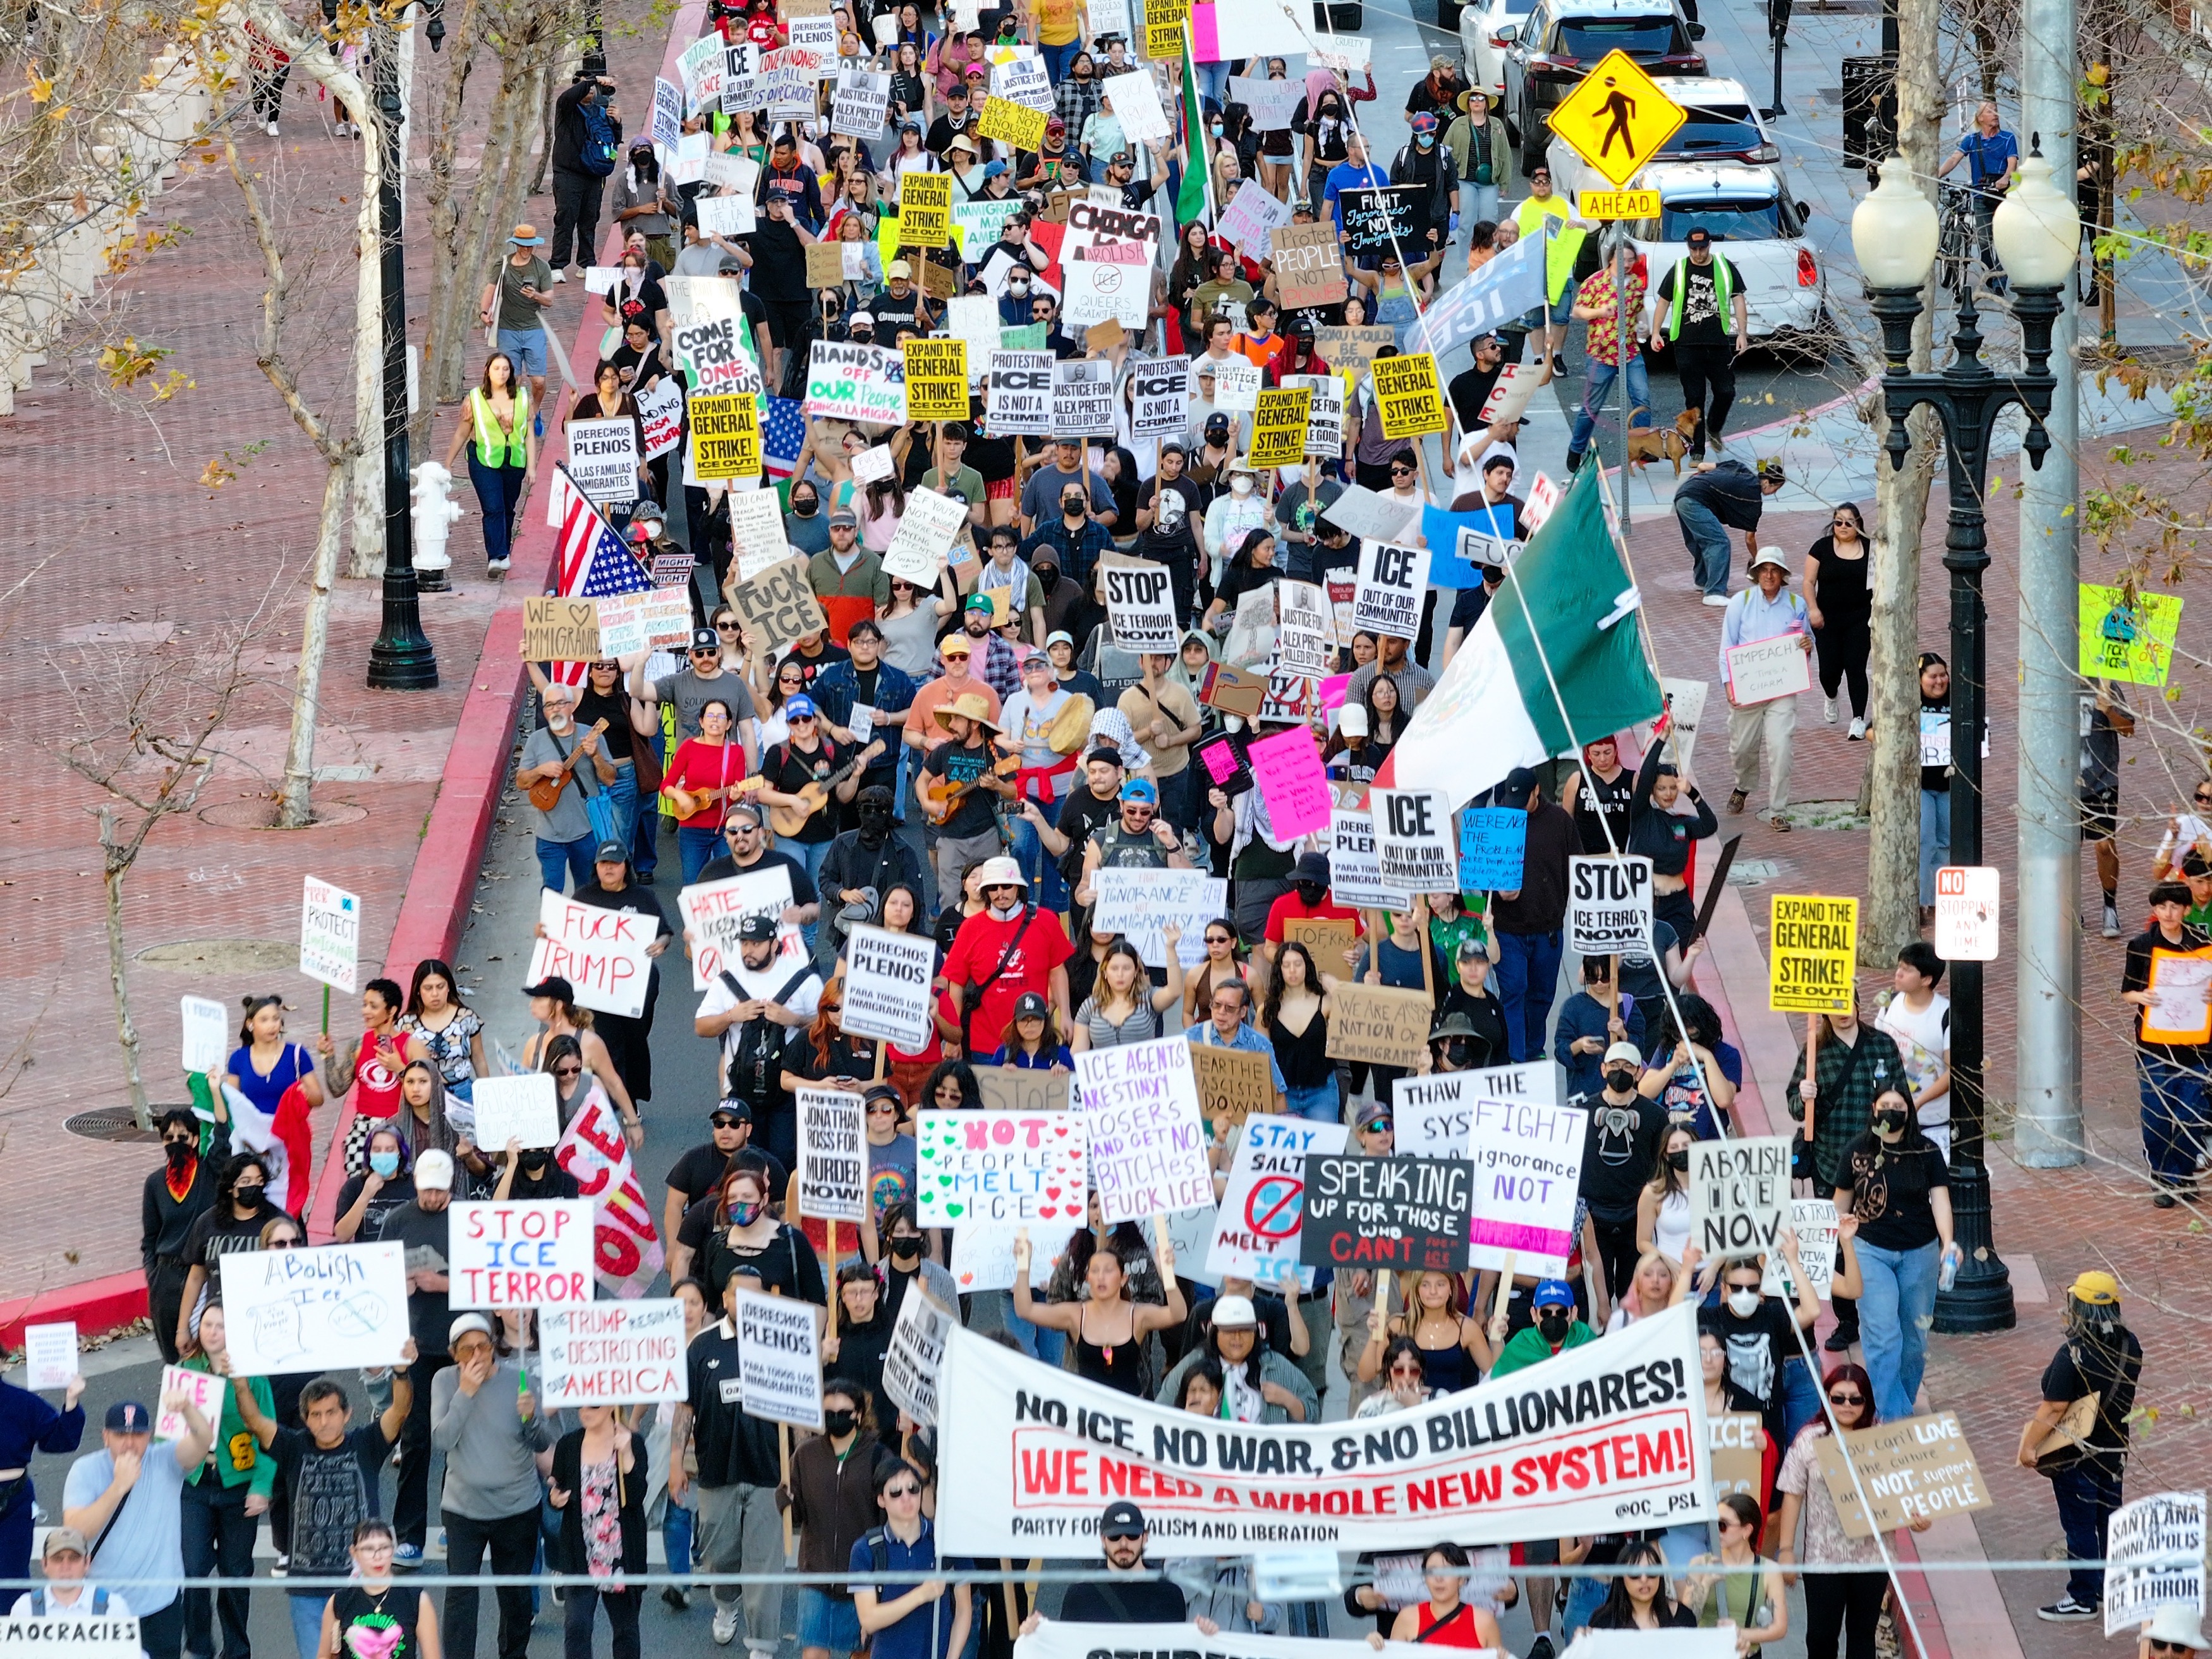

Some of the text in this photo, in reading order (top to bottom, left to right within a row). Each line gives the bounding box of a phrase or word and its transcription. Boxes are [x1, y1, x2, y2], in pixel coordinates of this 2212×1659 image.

[793, 23, 832, 32] ¡DERECHOS
[1093, 16, 1122, 30] RIGHT
[793, 32, 833, 44] PLENOS
[1335, 37, 1364, 47] CRUELTY
[728, 47, 749, 76] ICE
[838, 88, 885, 105] JUSTICE FOR
[836, 104, 882, 121] ALEX PRETTI
[989, 96, 1048, 122] TOO MUCH
[836, 115, 880, 130] KILLED BY CBP
[986, 118, 1033, 138] ENOUGH
[1017, 115, 1040, 130] NOT
[976, 124, 1039, 150] CARDBOARD
[904, 175, 949, 189] EXPAND THE
[902, 190, 947, 207] GENERAL
[1361, 193, 1401, 209] FIGHT
[1590, 195, 1650, 214] AHEAD
[904, 210, 944, 228] STRIKE!
[1069, 204, 1160, 243] CHINGA
[1281, 227, 1337, 248] Protect
[1087, 241, 1144, 262] ABOLISH
[1275, 243, 1341, 272] PEOPLE
[1097, 274, 1117, 285] ICE
[1295, 269, 1330, 287] NOT
[1080, 295, 1131, 309] QUEERS
[1284, 283, 1346, 307] POWER
[1073, 308, 1109, 319] AGAINST
[678, 319, 733, 350] COME
[1315, 327, 1392, 341] GOKU WOULD
[695, 341, 733, 369] FOR
[813, 344, 883, 371] HANDS
[992, 354, 1052, 368] PROTESTING
[1340, 343, 1358, 356] BE
[700, 360, 749, 385] ONE,
[842, 367, 872, 381] OFF
[992, 372, 1050, 389] ICE
[1215, 373, 1258, 384] JUSTICE
[810, 380, 856, 401] OUR
[999, 396, 1042, 410] IS NOT A
[989, 413, 1048, 422] CRIME!
[573, 427, 630, 441] ¡DERECHOS
[574, 439, 631, 455] PLENOS
[595, 463, 631, 475] FAMILIAS
[930, 515, 957, 532] ANGRY
[898, 528, 928, 546] PAYING
[1373, 545, 1416, 590] ICE
[733, 564, 808, 618] FUCK
[1107, 571, 1167, 604] STOP
[528, 600, 555, 623] WE
[1363, 589, 1415, 611] OUT OF OUR
[751, 600, 820, 652] ICE
[1111, 612, 1172, 629] ICE TERROR
[1356, 602, 1418, 627] COMMUNITIES
[524, 626, 599, 658] IMMIGRANTS
[1115, 631, 1174, 640] NOW!
[1942, 872, 1962, 892] NO
[689, 888, 742, 923] HATE
[1104, 886, 1194, 904] IGNORANCE
[1940, 900, 1994, 915] STOPPING
[308, 906, 356, 941] PROTECT
[563, 906, 635, 943] FUCK
[1956, 921, 1978, 930] ANY
[1775, 921, 1850, 951] GENERAL
[1954, 937, 1980, 947] TIME
[855, 937, 928, 963] ¡DERECHOS
[537, 939, 635, 995] TRUMP
[853, 954, 925, 985] PLENOS
[1779, 957, 1845, 985] STRIKE!
[848, 997, 921, 1023] INMIGRANTES!
[849, 987, 923, 1011] PARA TODOS LOS
[1338, 995, 1390, 1020] WE ARE
[1340, 1019, 1394, 1038] NATION
[1083, 1042, 1185, 1083] ICE AGENTS
[1404, 1073, 1527, 1106] THAW THE
[1206, 1092, 1263, 1113] DOWN
[805, 1107, 860, 1131] JONATHAN
[1088, 1101, 1181, 1139] LOSERS
[1476, 1100, 1581, 1145] FIGHT
[808, 1130, 858, 1153] ROSS FOR
[964, 1119, 1048, 1150] HOT
[1249, 1122, 1316, 1151] STAY
[806, 1155, 860, 1186] MURDER
[944, 1152, 1051, 1170] PEOPLE
[1250, 1155, 1304, 1174] SALT
[1478, 1146, 1577, 1179] ignorance
[1699, 1147, 1786, 1181] ABOLISH
[802, 1184, 863, 1201] NOW!
[955, 1169, 1046, 1193] MELT
[1318, 1159, 1466, 1212] SPEAKING
[1493, 1175, 1553, 1203] NOT
[1103, 1177, 1212, 1219] FUCK ICE!
[467, 1210, 569, 1239] STOP
[1310, 1198, 1458, 1236] UP FOR THOSE
[1359, 1225, 1402, 1241] WHO
[1704, 1210, 1781, 1253] NOW
[486, 1241, 557, 1268] ICE
[1330, 1232, 1415, 1263] CANT
[461, 1269, 588, 1304] TERROR
[566, 1308, 627, 1334] TRUMP
[568, 1336, 676, 1364] DESTROYING
[563, 1367, 679, 1397] AMERICA
[1016, 1389, 1067, 1429] NO
[1153, 1425, 1207, 1466] NO
[1217, 1434, 1323, 1480] WAR,
[1426, 1358, 1688, 1454] BILLIONARES!
[1914, 1417, 1960, 1445] LOVE
[1022, 1427, 1689, 1515] WE NEED A WHOLE NEW SYSTEM!
[1871, 1460, 1973, 1499] NOT support
[1615, 1492, 1701, 1518] @OC_PSL
[1900, 1481, 1979, 1517] PEOPLE
[2164, 1500, 2199, 1524] ANA
[1012, 1517, 1339, 1541] PARTY AND LIBERATION
